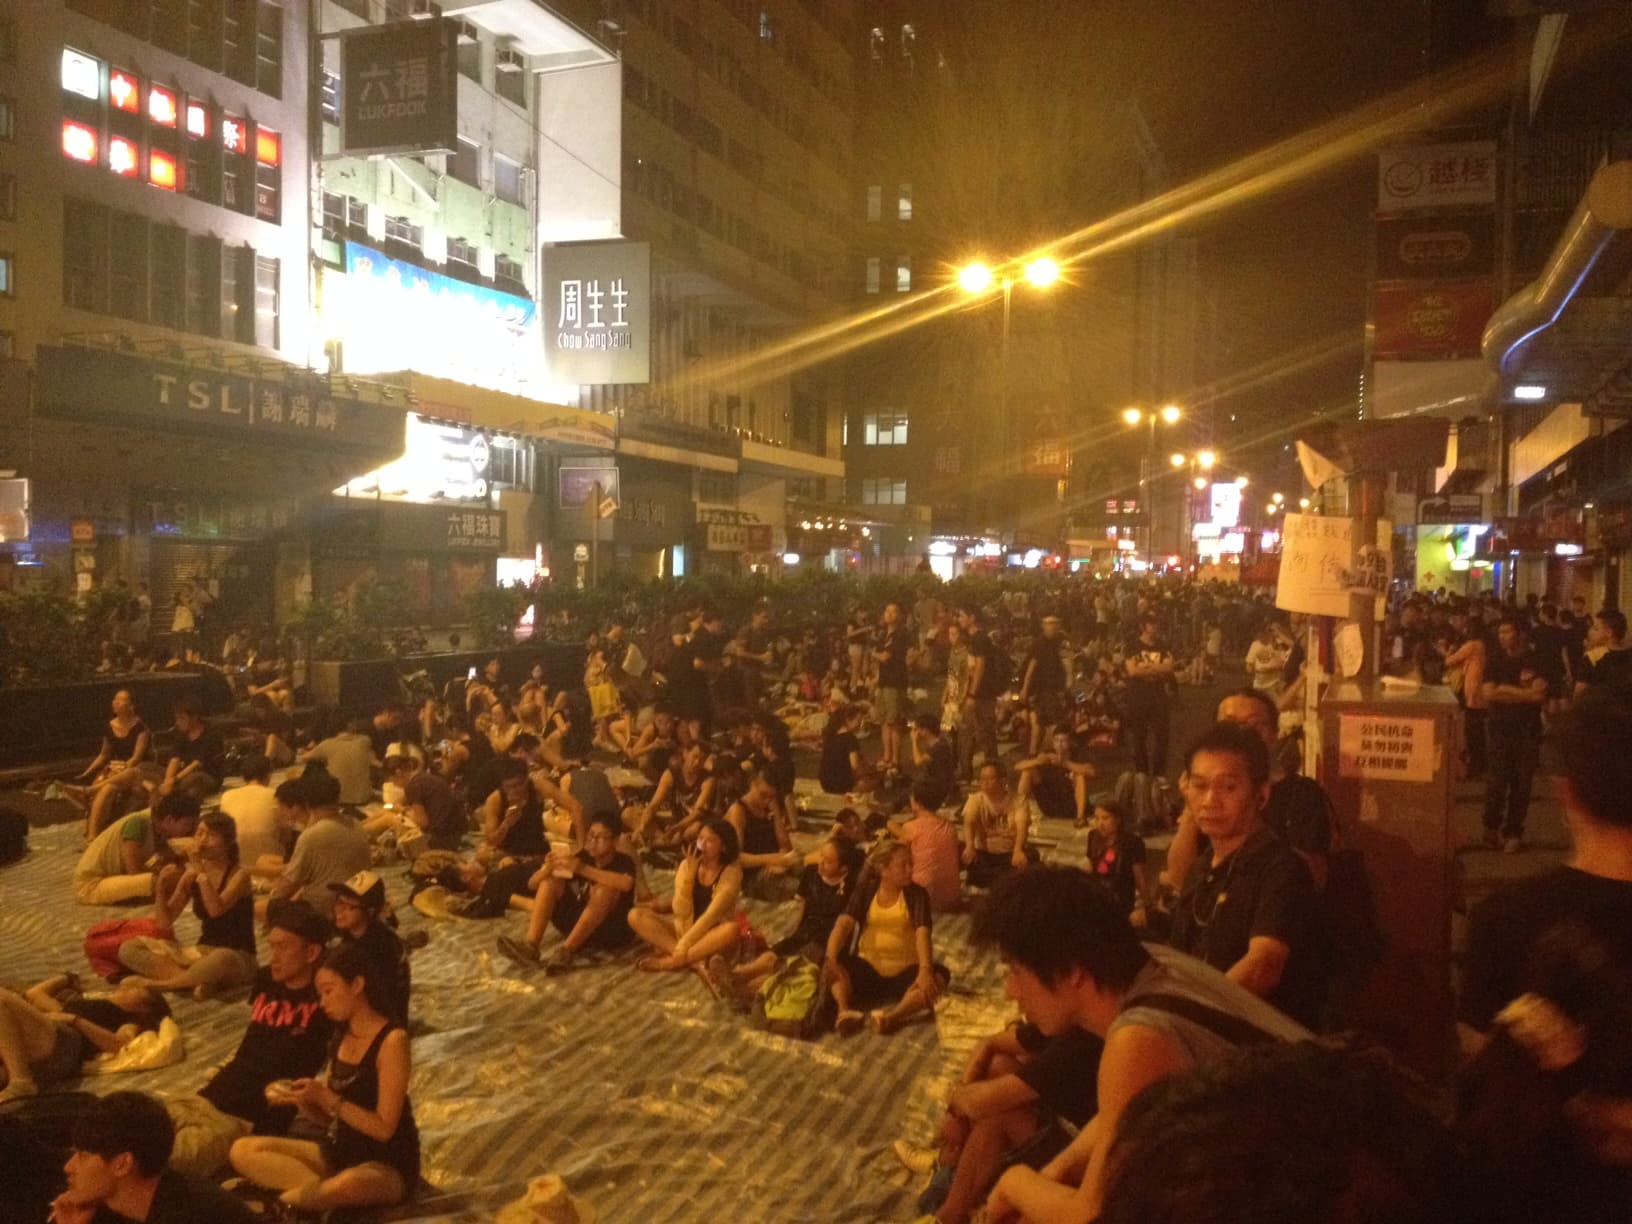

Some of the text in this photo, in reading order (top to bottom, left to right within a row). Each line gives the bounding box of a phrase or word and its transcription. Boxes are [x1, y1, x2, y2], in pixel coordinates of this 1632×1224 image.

[359, 57, 428, 102] 六福
[558, 278, 629, 328] 周生生
[558, 330, 632, 350] Chow Sang Sang
[152, 374, 241, 415] TSL
[447, 512, 501, 537] 六福珠寶
[1361, 724, 1413, 737] 公民抗命
